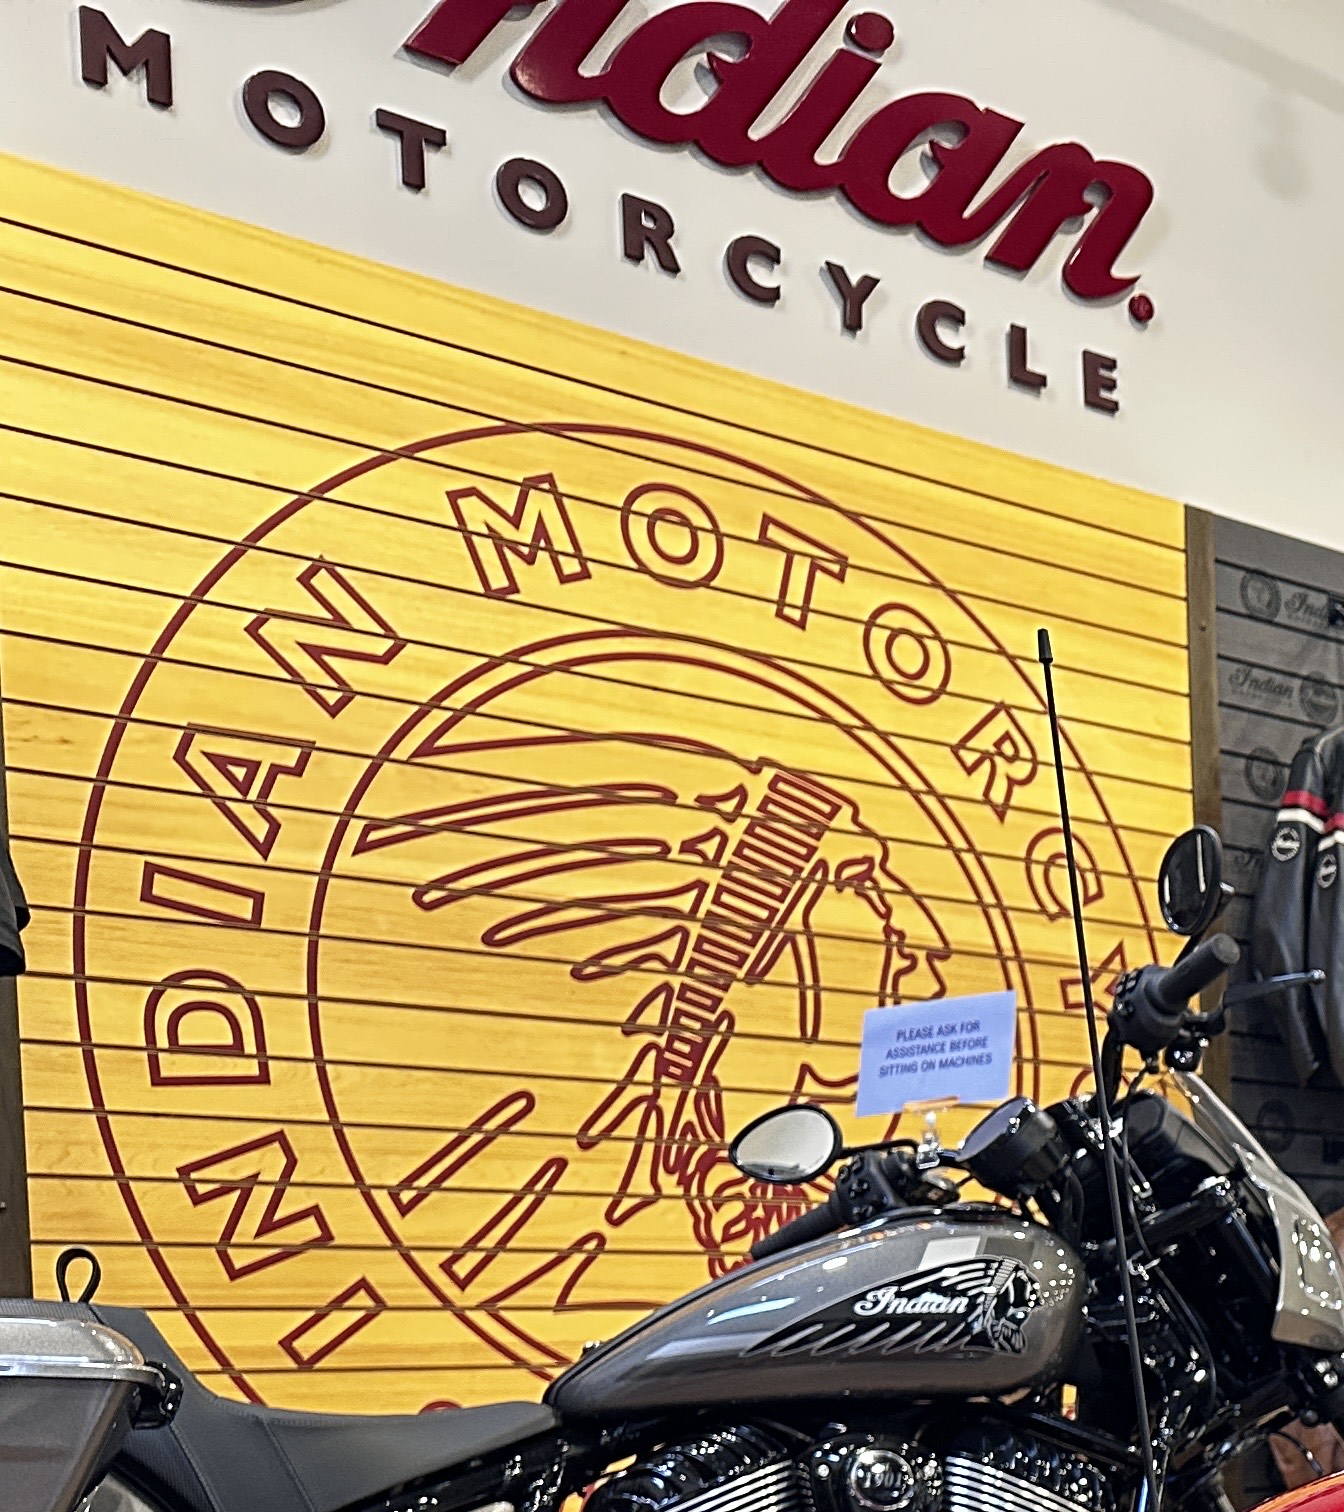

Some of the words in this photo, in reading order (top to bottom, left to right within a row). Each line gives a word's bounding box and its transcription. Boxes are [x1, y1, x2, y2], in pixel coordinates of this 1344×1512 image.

[76, 4, 1121, 414] MOTORCYCLE
[1228, 665, 1295, 700] Indian
[141, 555, 407, 1369] INDIAN
[896, 1025, 935, 1042] PLEASE
[936, 1022, 957, 1037] ASK
[960, 1020, 980, 1033] FOR
[885, 1041, 947, 1060] ASSISTANCE
[949, 1036, 988, 1051] BEFORE
[878, 1061, 918, 1078] SITTING
[920, 1059, 936, 1072] ON
[938, 1052, 993, 1069] MACHINES
[853, 1284, 970, 1316] Indian
[863, 1470, 904, 1490] 1901
